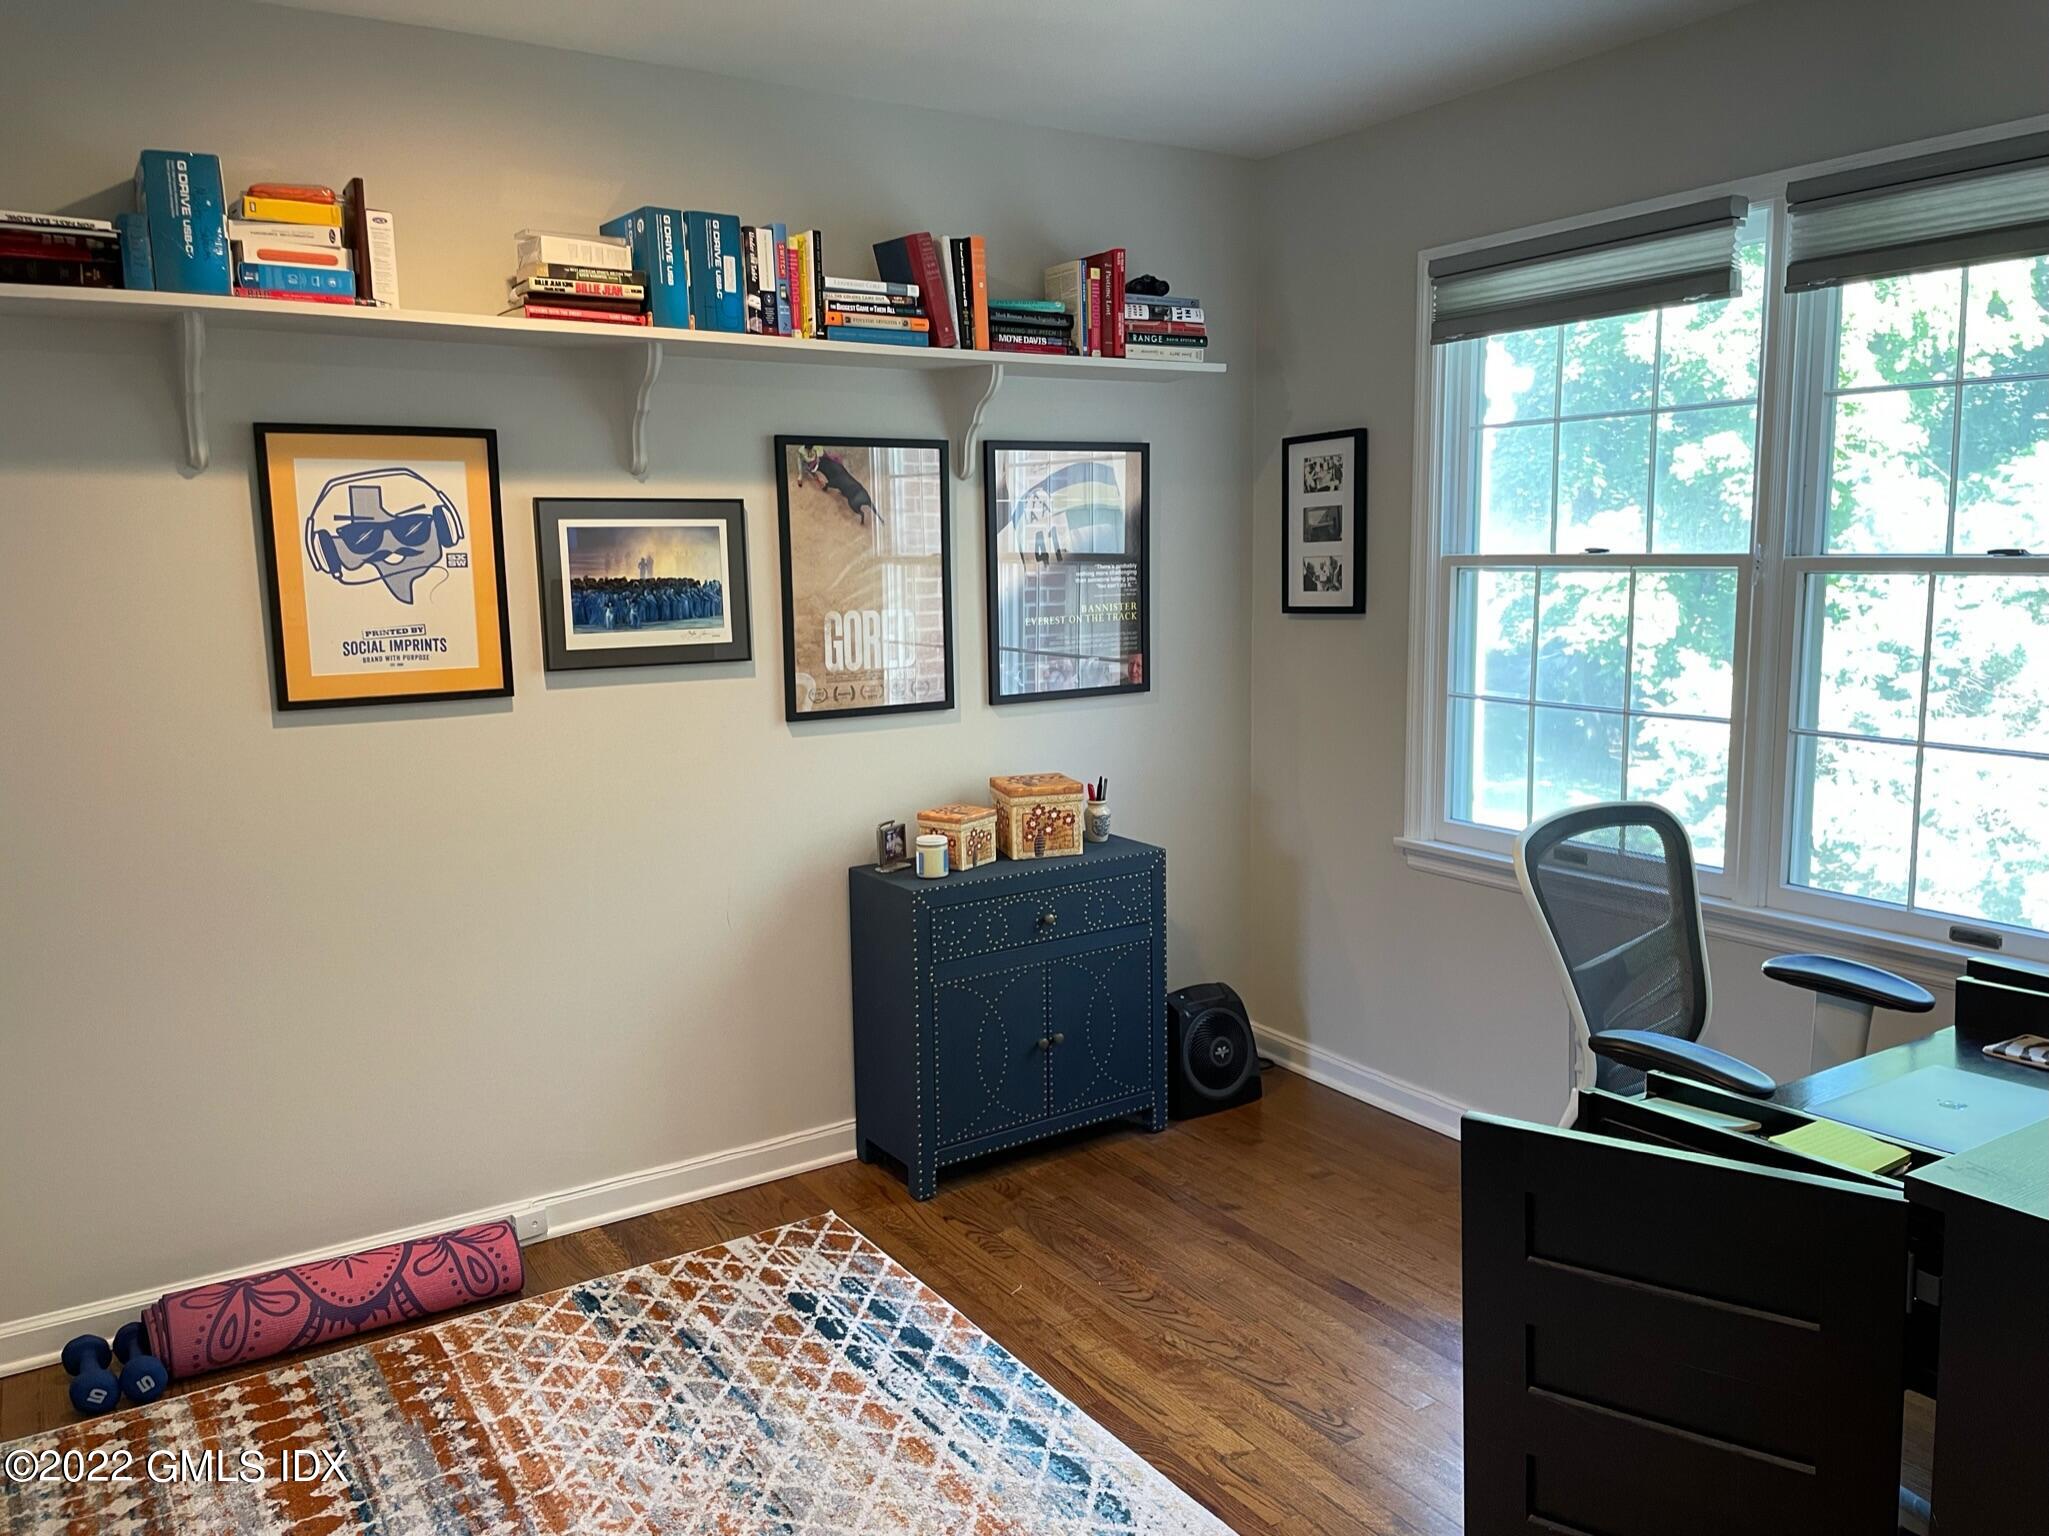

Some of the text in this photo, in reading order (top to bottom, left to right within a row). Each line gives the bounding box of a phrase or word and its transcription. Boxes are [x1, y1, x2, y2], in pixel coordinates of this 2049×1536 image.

[177, 160, 187, 172] G
[178, 173, 192, 217] DRIVE
[712, 219, 720, 229] G
[663, 214, 675, 286] G DRIVE USB
[713, 230, 722, 269] DRIVE
[778, 244, 786, 275] SWITCH
[534, 279, 549, 287] BILLIE
[575, 282, 624, 297] BILLIE JEAN
[836, 303, 856, 311] BIGGEST
[856, 304, 869, 312] GAME
[874, 305, 887, 313] THEM
[887, 306, 896, 314] ALL
[1185, 309, 1191, 318] IN
[1023, 335, 1047, 345] DAVIS
[1132, 334, 1163, 343] RANGE
[1081, 601, 1137, 613] BANNISTER
[1025, 611, 1137, 626] EVEREST ON THE TRACK
[365, 626, 424, 637] PRINTED BY
[343, 637, 447, 656] SOCIAL IMPRINTS
[824, 610, 916, 672] GORED
[362, 653, 430, 663] BRAND WITH PURPOSE
[136, 1375, 156, 1393] 5
[86, 1388, 108, 1404] 5
